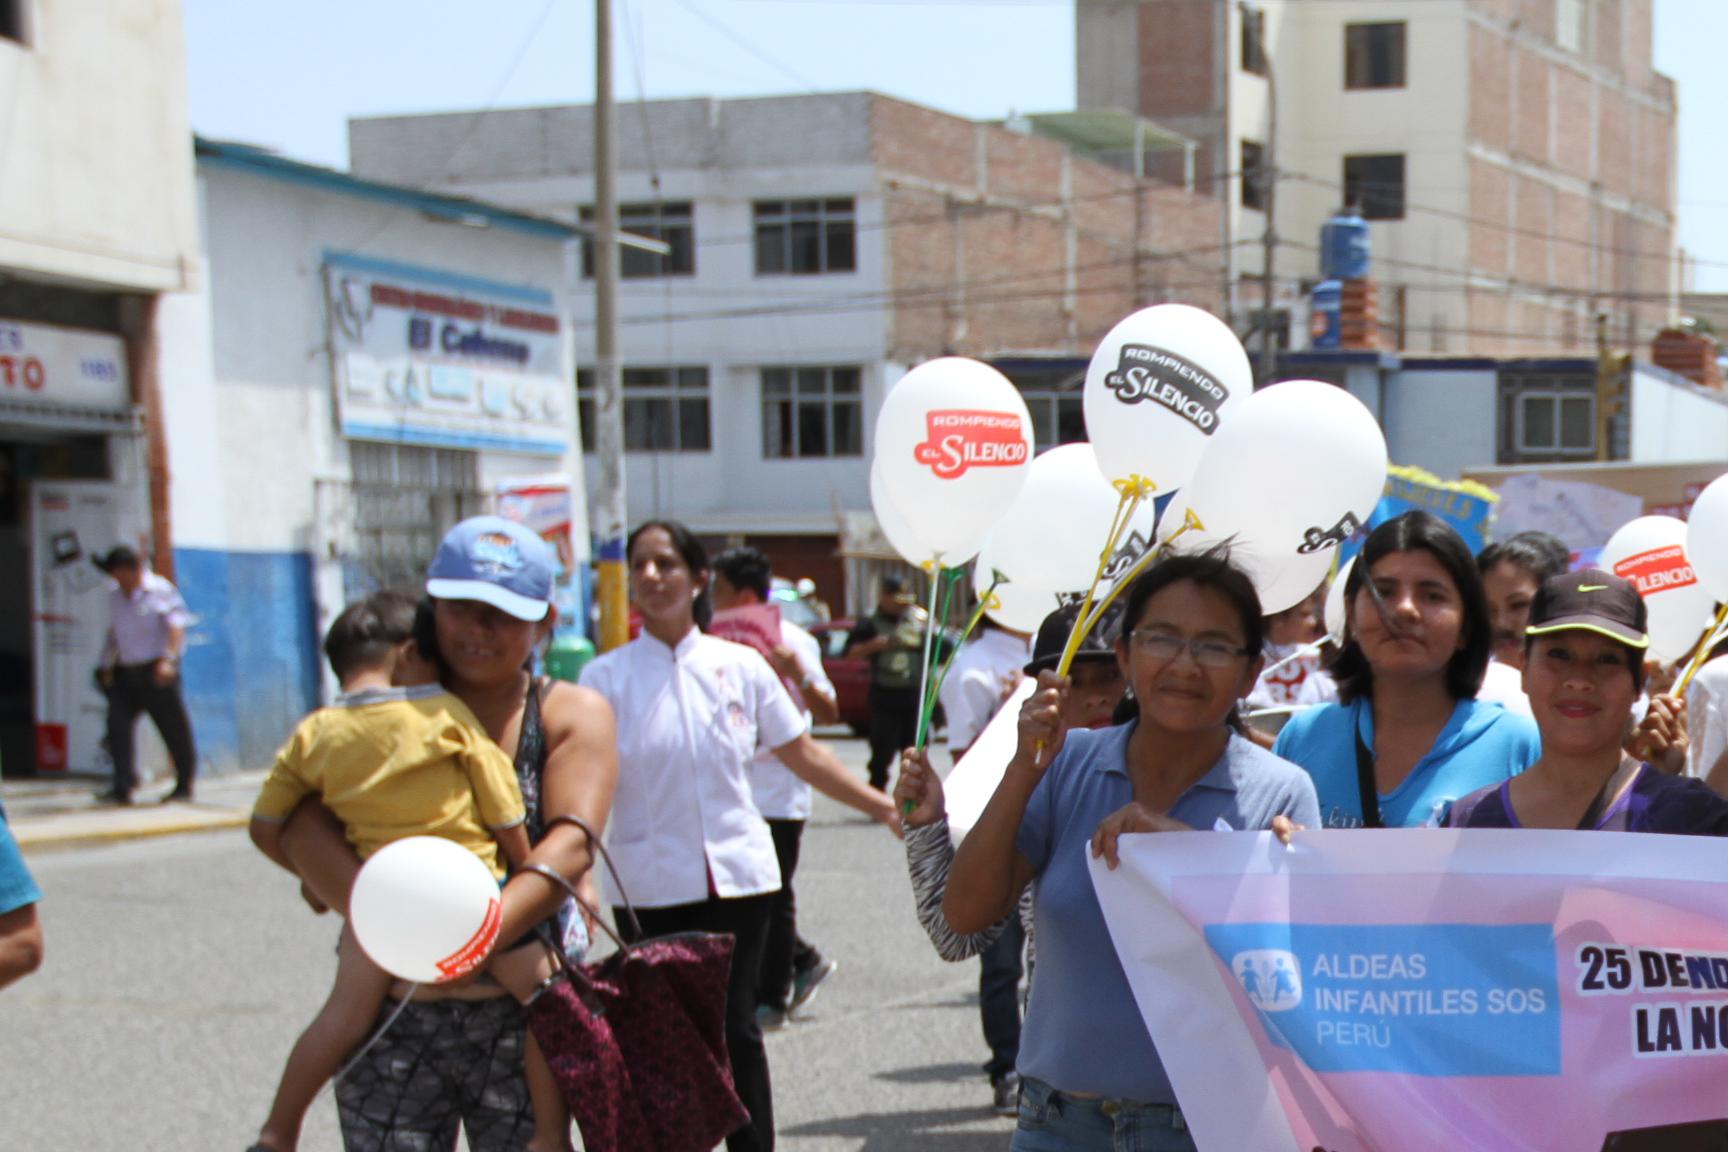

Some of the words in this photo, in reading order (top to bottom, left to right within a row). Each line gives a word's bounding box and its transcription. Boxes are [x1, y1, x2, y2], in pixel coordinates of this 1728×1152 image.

[1125, 348, 1225, 400] ROMPIENDO
[1109, 375, 1124, 385] EL
[1118, 367, 1214, 428] SILENCIO
[933, 415, 1020, 429] ROMPIENDO
[922, 448, 940, 458] EL
[936, 434, 1025, 472] SILENCIO
[1312, 953, 1428, 980] ALDEAS
[1580, 945, 1632, 991] 25
[1638, 949, 1688, 988] DE
[1315, 987, 1480, 1015] INFANTILES
[1487, 987, 1547, 1014] SOS
[1317, 1018, 1391, 1048] PERÚ
[1636, 1006, 1682, 1053] LA
